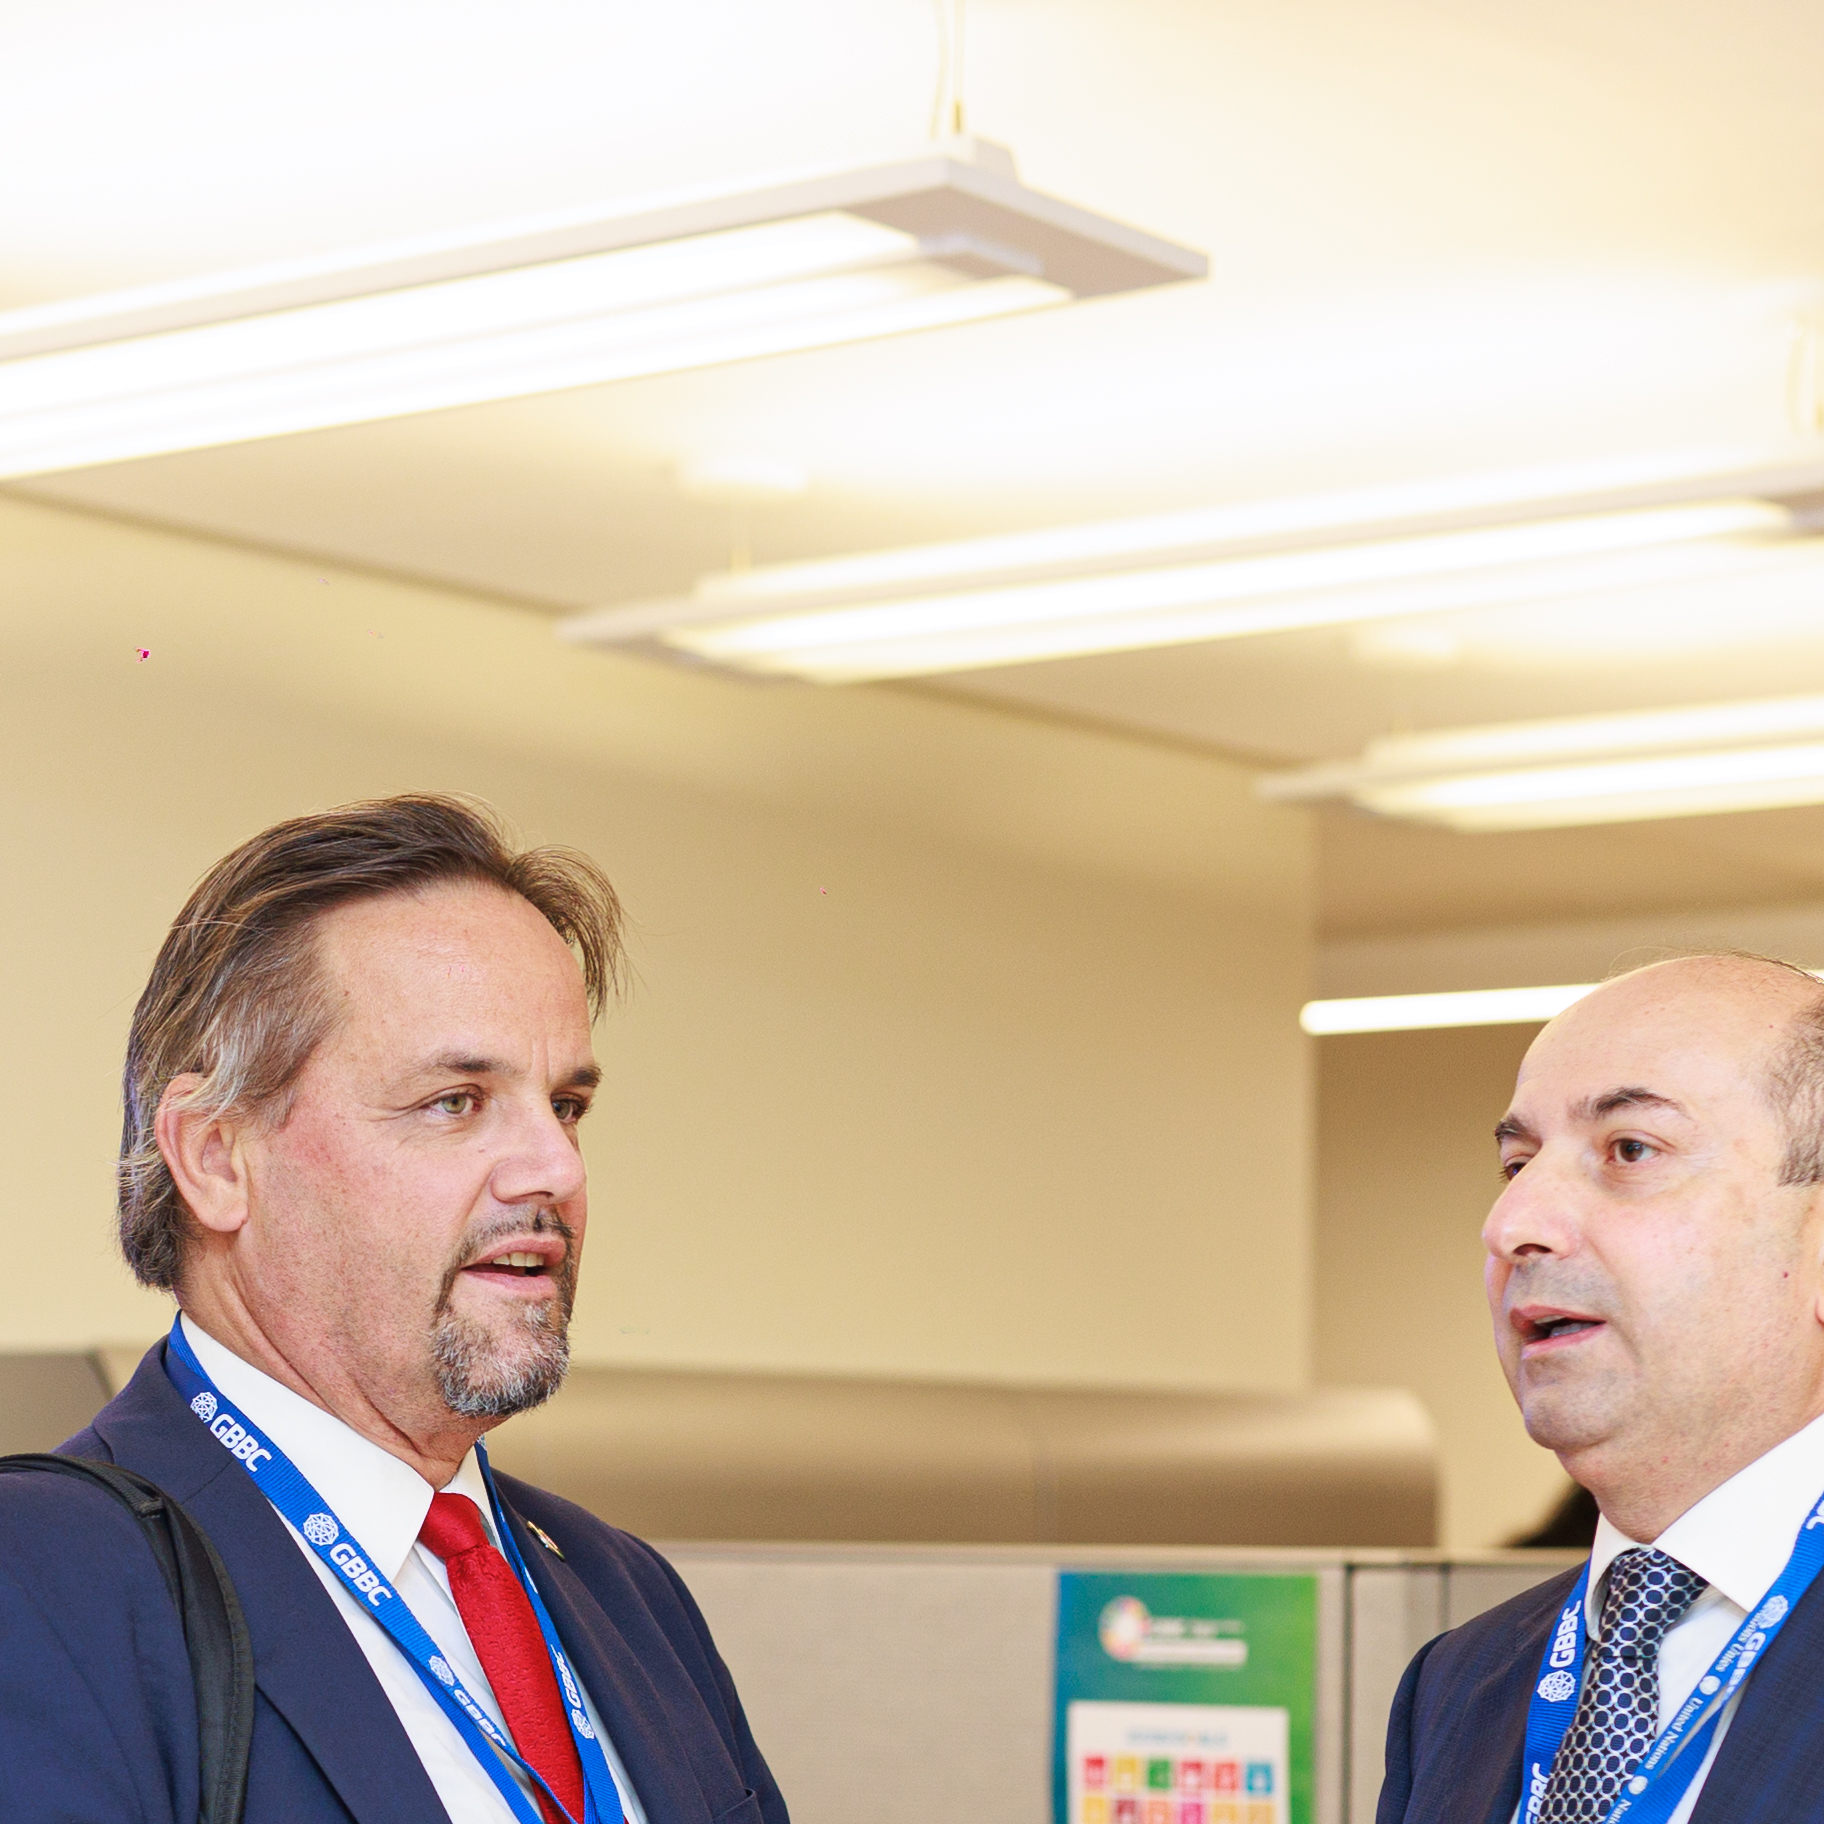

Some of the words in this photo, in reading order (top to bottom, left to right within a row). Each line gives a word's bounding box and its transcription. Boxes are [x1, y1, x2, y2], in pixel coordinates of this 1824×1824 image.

[210, 1413, 272, 1472] GBBC
[329, 1543, 392, 1606] GBBC
[1549, 1600, 1582, 1668] GBBC
[550, 1644, 581, 1708] GBBC
[1671, 1697, 1704, 1733] United
[1643, 1731, 1679, 1770] Nations
